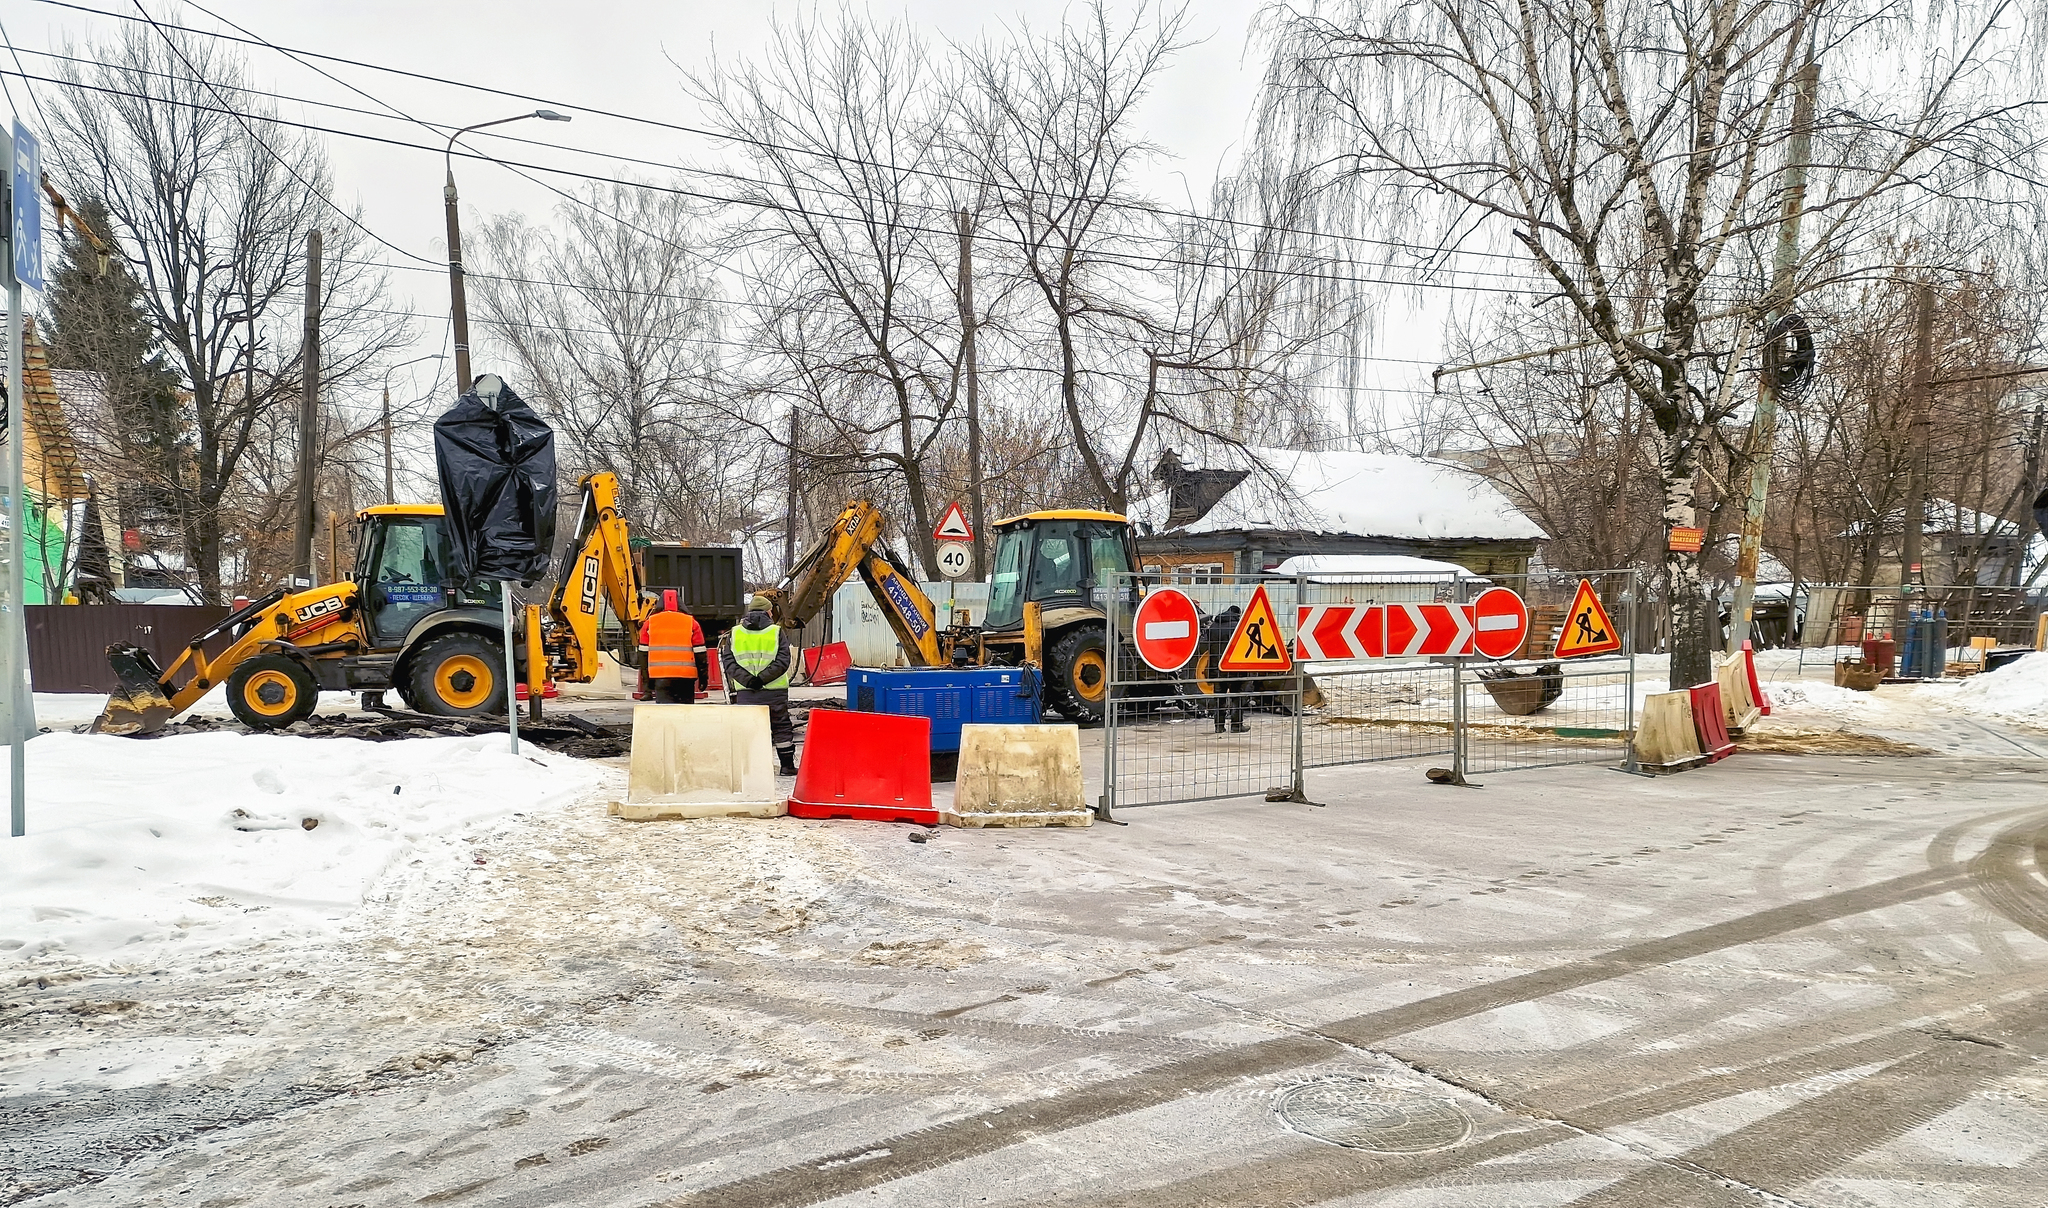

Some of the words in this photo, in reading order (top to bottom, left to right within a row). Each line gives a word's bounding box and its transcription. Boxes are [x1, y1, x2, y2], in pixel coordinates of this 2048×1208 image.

[943, 552, 964, 567] 40
[299, 597, 343, 620] JCB
[582, 558, 598, 614] JCB
[888, 586, 921, 634] 413-48-50
[891, 577, 909, 602] АРЕНДА
[908, 601, 927, 629] ТЕХНИКИ
